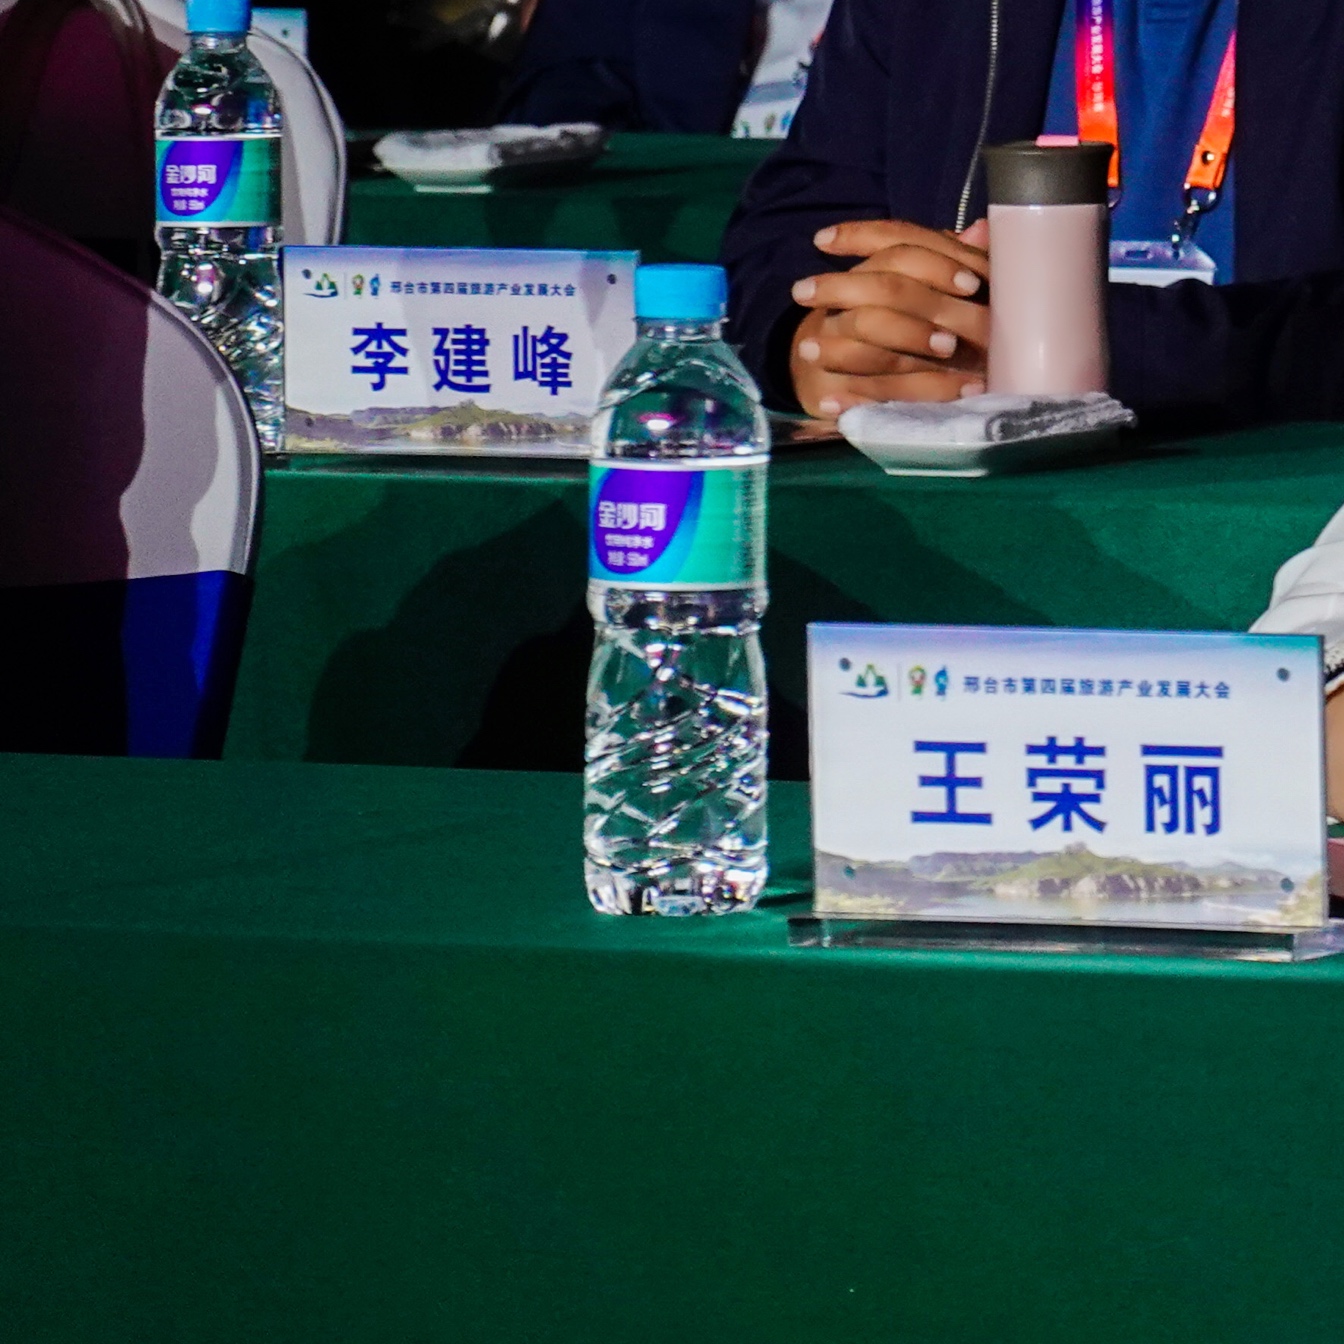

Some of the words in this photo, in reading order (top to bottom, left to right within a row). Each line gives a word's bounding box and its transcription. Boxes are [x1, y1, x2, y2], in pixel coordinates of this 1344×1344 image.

[389, 280, 576, 297] 邢台市第四届旅游产业发展大会
[349, 322, 573, 396] 李建峰
[963, 675, 1231, 700] 邢台市第四届旅游产业发展大会
[910, 736, 1224, 836] 王荣丽
